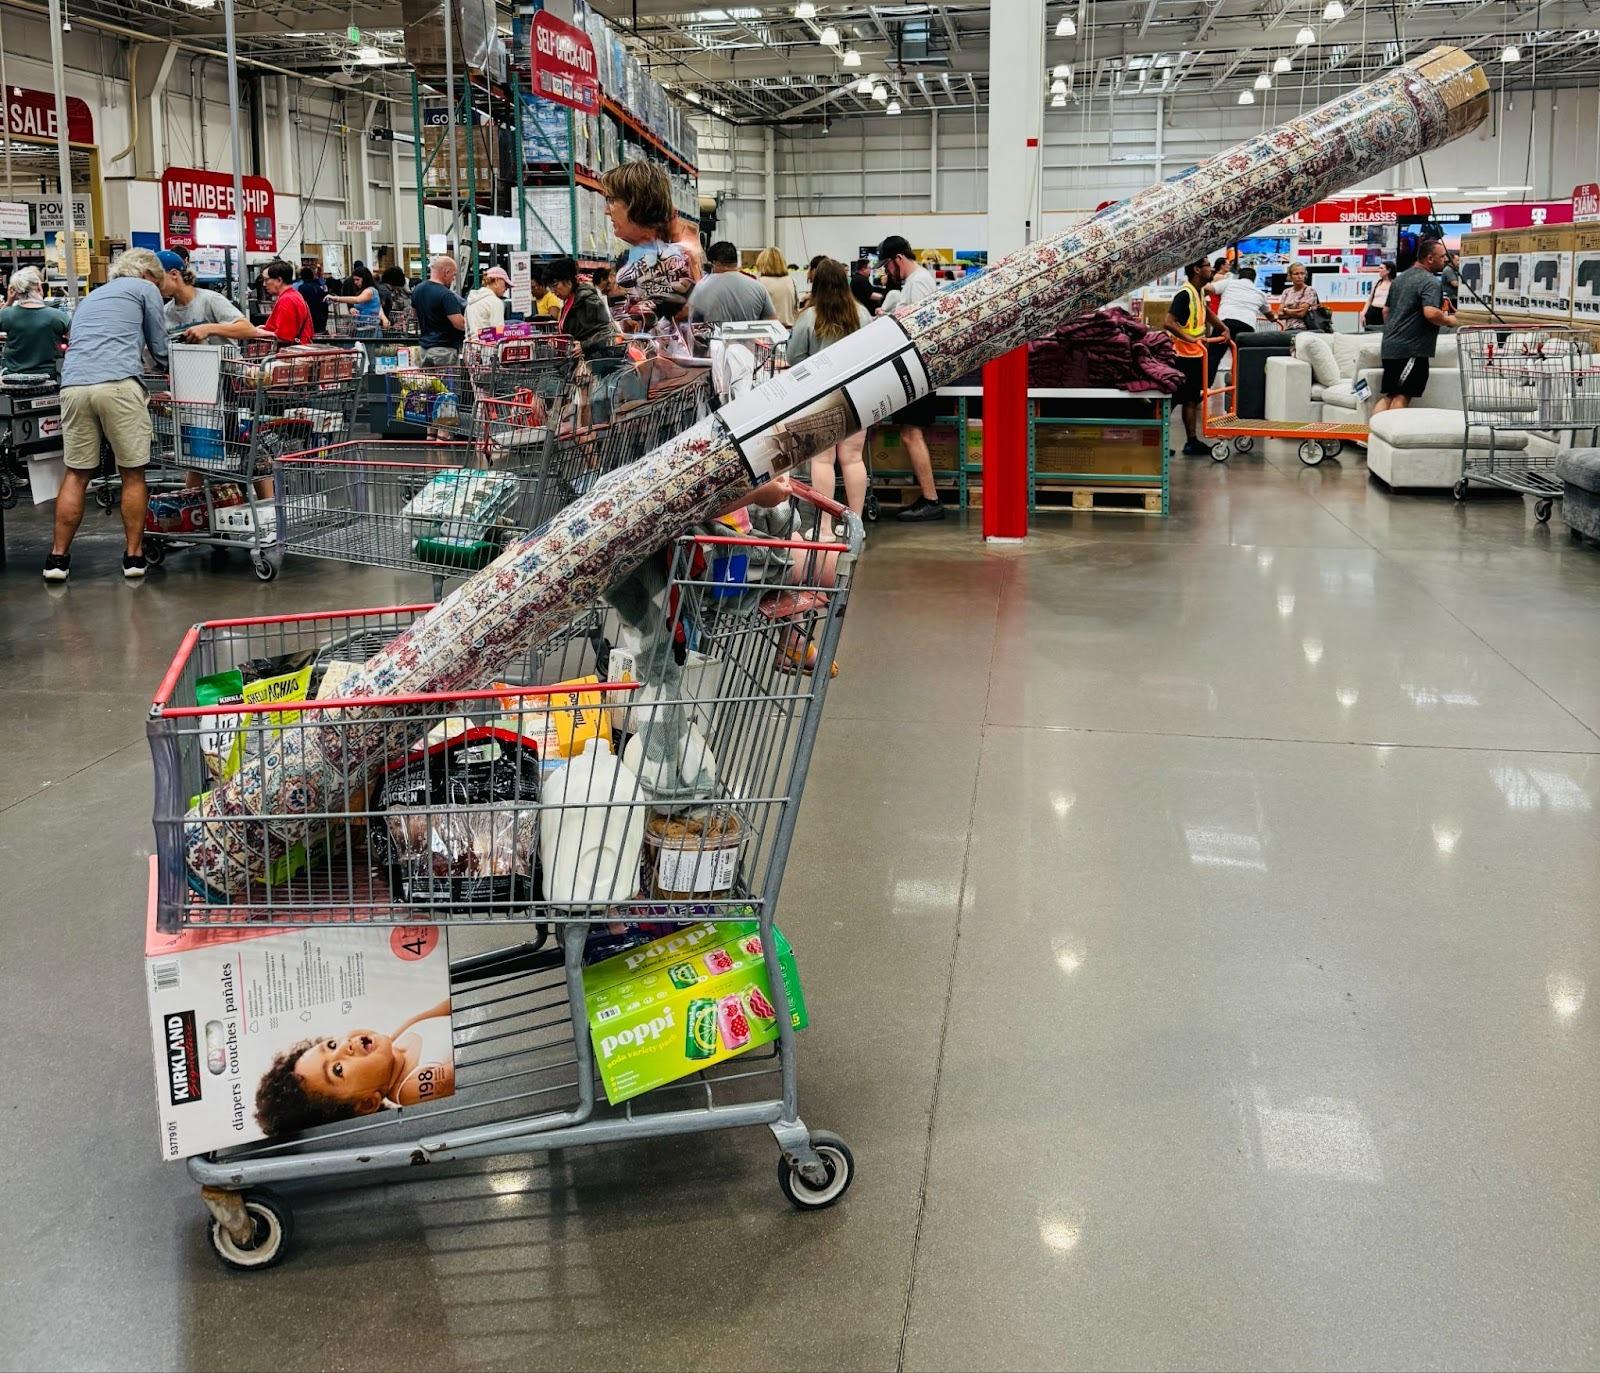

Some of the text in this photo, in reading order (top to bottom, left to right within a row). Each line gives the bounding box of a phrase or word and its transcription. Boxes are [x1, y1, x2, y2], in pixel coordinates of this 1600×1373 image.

[536, 25, 555, 56] SELF
[10, 103, 69, 138] SALE
[1339, 212, 1397, 222] SUNGLASSES
[1574, 195, 1598, 215] EXAMS
[22, 420, 32, 441] 9
[218, 694, 244, 704] KIRKLA
[402, 937, 427, 955] 4
[624, 921, 720, 970] poppi
[222, 962, 244, 1131] diapers couches pañales
[600, 1006, 675, 1058] poppi
[168, 1015, 190, 1101] KIRKLAND
[419, 1069, 434, 1100] 198
